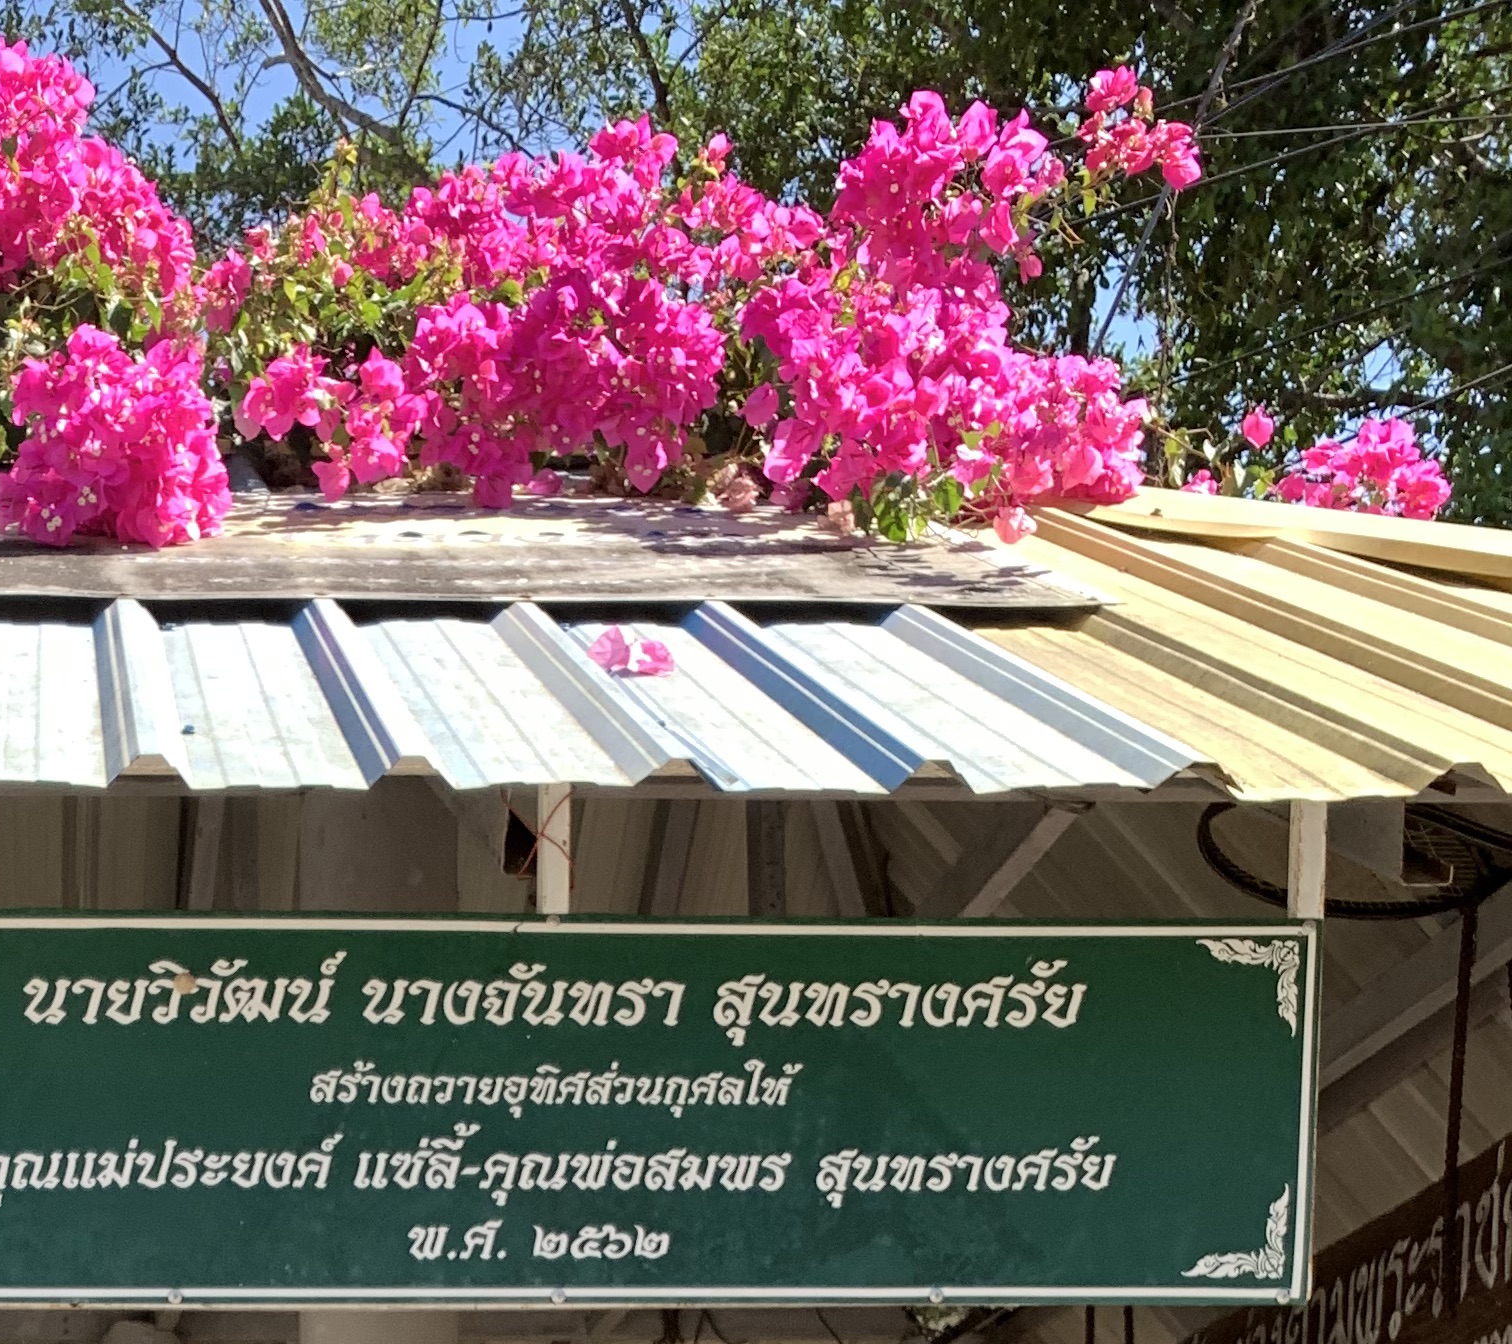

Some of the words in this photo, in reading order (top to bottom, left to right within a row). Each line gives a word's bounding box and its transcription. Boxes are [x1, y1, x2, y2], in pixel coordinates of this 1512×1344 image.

[23, 951, 348, 1026] นายวิวัฒน์
[362, 962, 687, 1027] นางจันทรา
[713, 959, 1088, 1047] สุนทรางศรัย
[309, 1058, 804, 1119] สร้างถวายอุทิศส่วนกุศลให้
[814, 1135, 1118, 1209] สุนทรางศรัย
[406, 1219, 507, 1262] พ.ศ.
[532, 1223, 671, 1261] ๒๕๖๒
